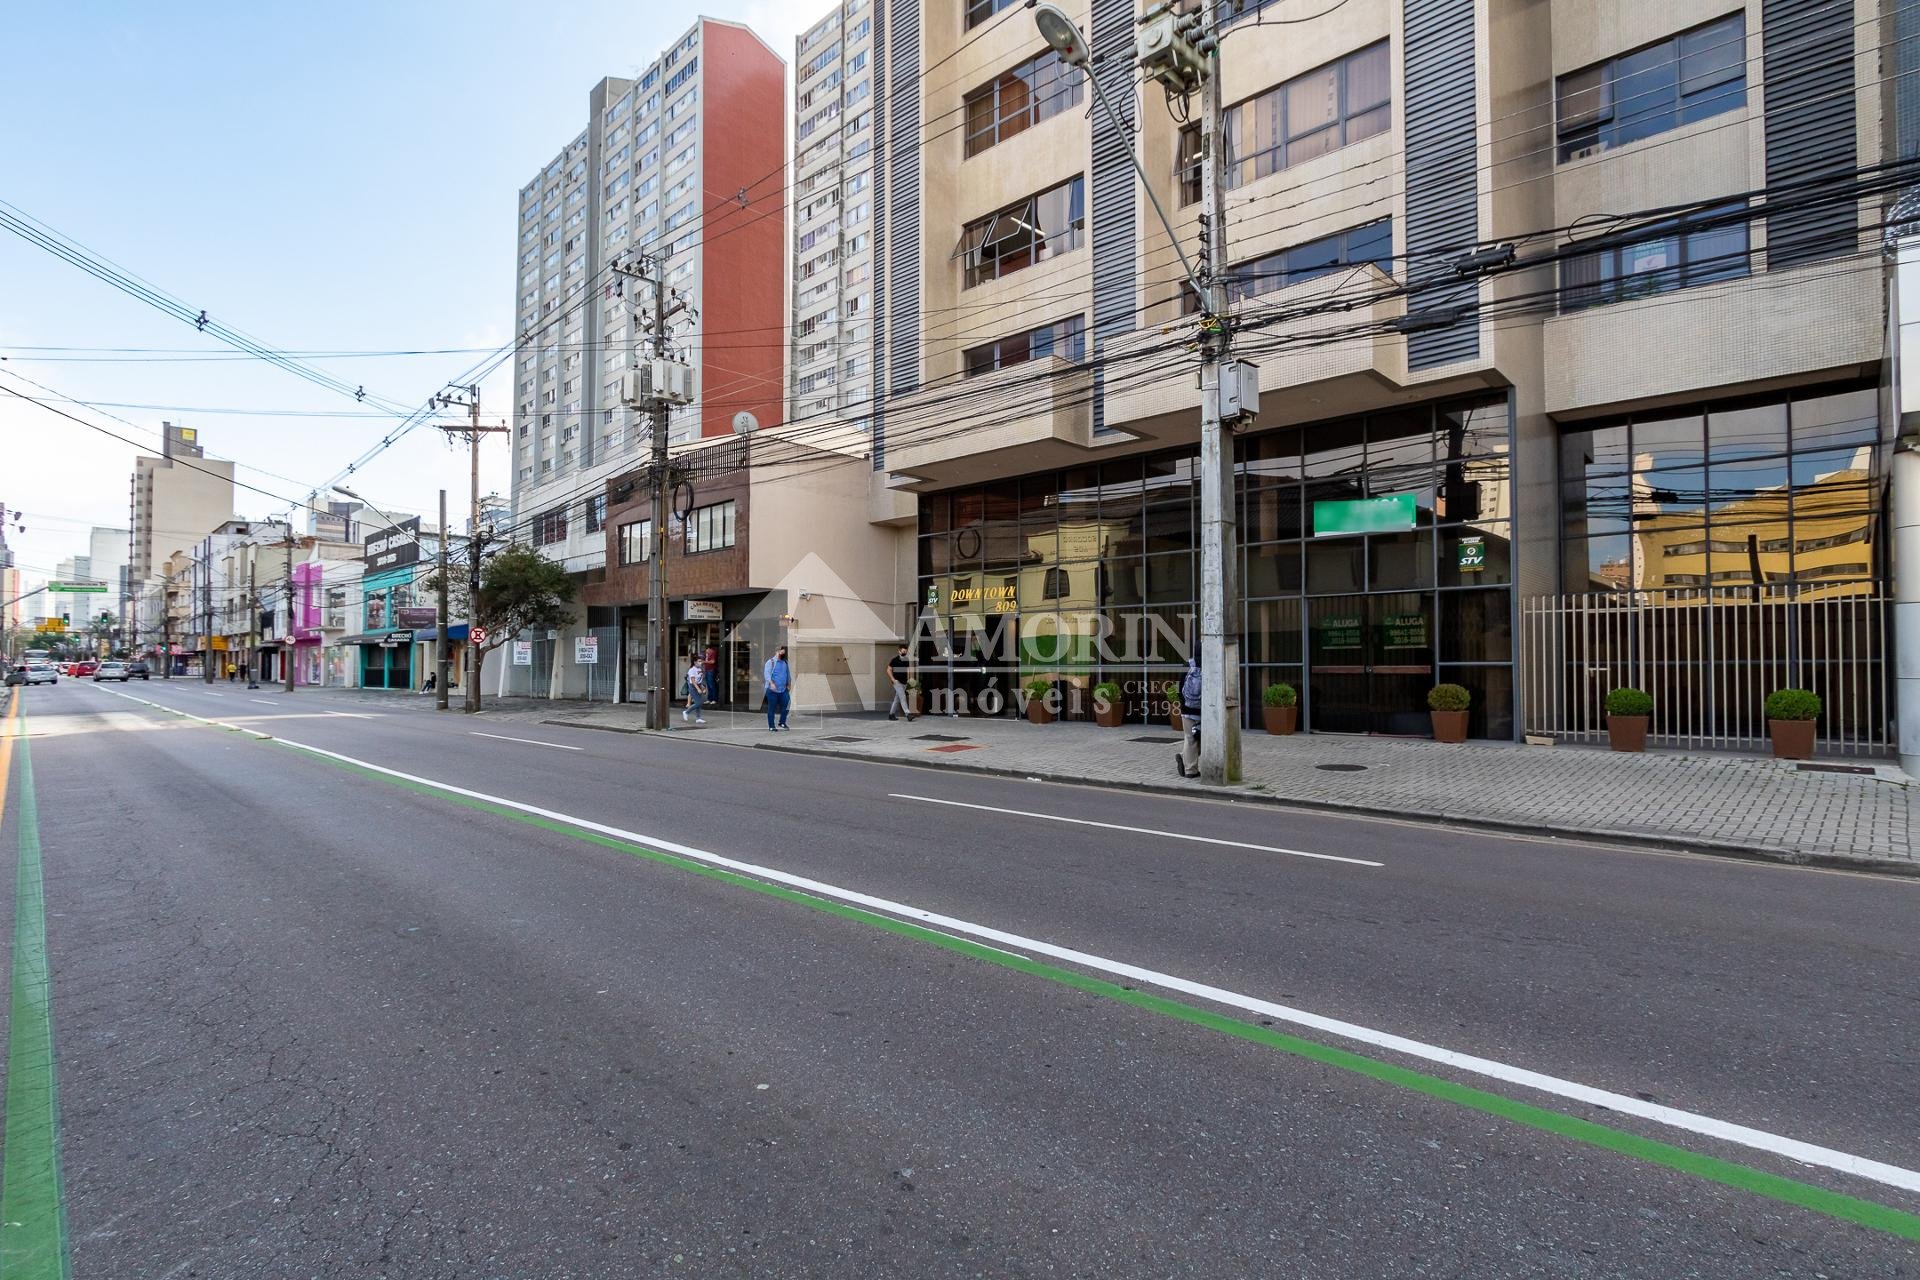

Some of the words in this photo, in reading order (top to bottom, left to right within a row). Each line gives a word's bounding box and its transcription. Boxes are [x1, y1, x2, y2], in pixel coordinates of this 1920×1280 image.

[1460, 556, 1483, 565] STV
[951, 586, 1016, 601] DOWNTOWN
[996, 600, 1017, 612] 809
[1333, 619, 1359, 628] ALUGA
[1396, 617, 1424, 626] ALUGA
